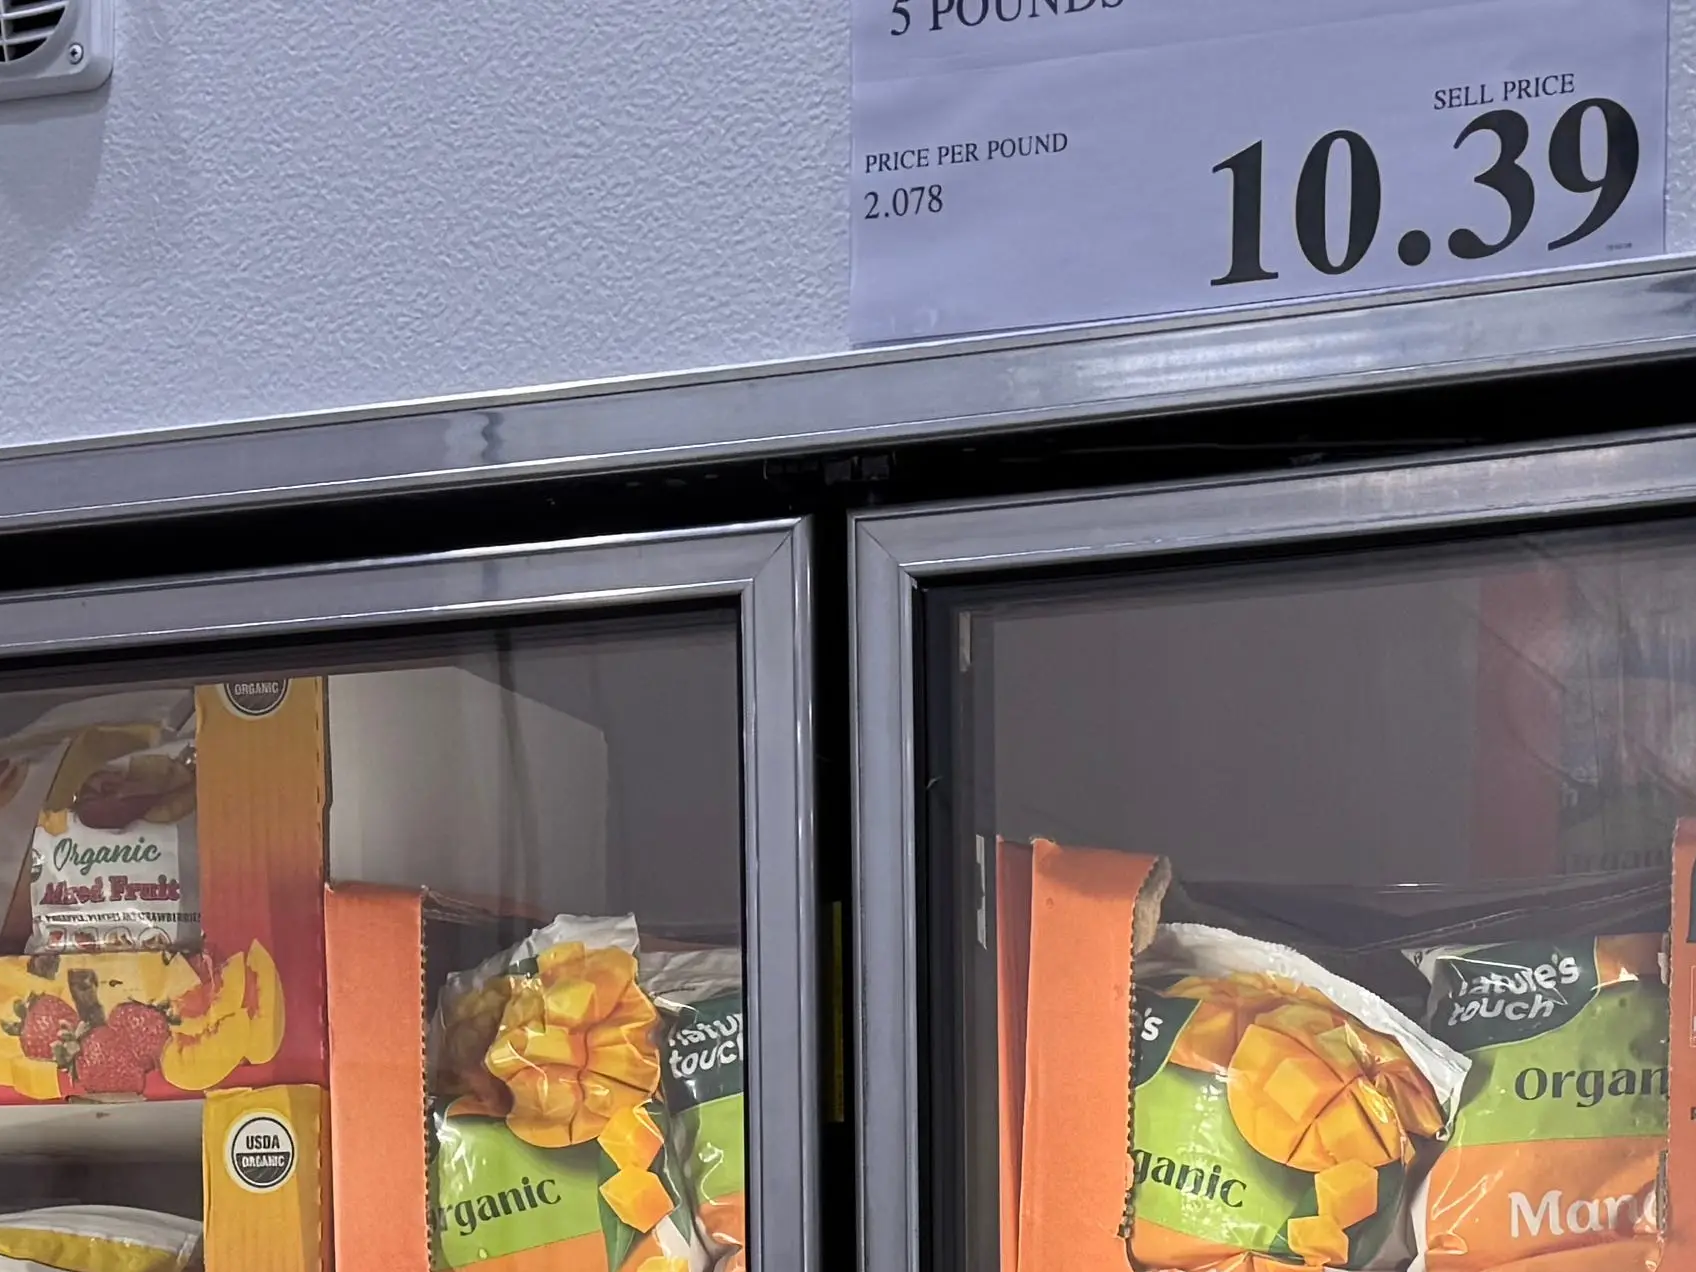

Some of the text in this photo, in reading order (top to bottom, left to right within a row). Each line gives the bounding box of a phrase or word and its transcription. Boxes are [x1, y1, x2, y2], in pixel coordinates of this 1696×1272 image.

[891, 0, 910, 35] 5
[1433, 73, 1575, 111] SELL PRICE
[864, 132, 1068, 174] PRICE PER POUND
[864, 184, 944, 219] 2.078
[1210, 97, 1640, 287] 10.39
[246, 1136, 281, 1150] USDA
